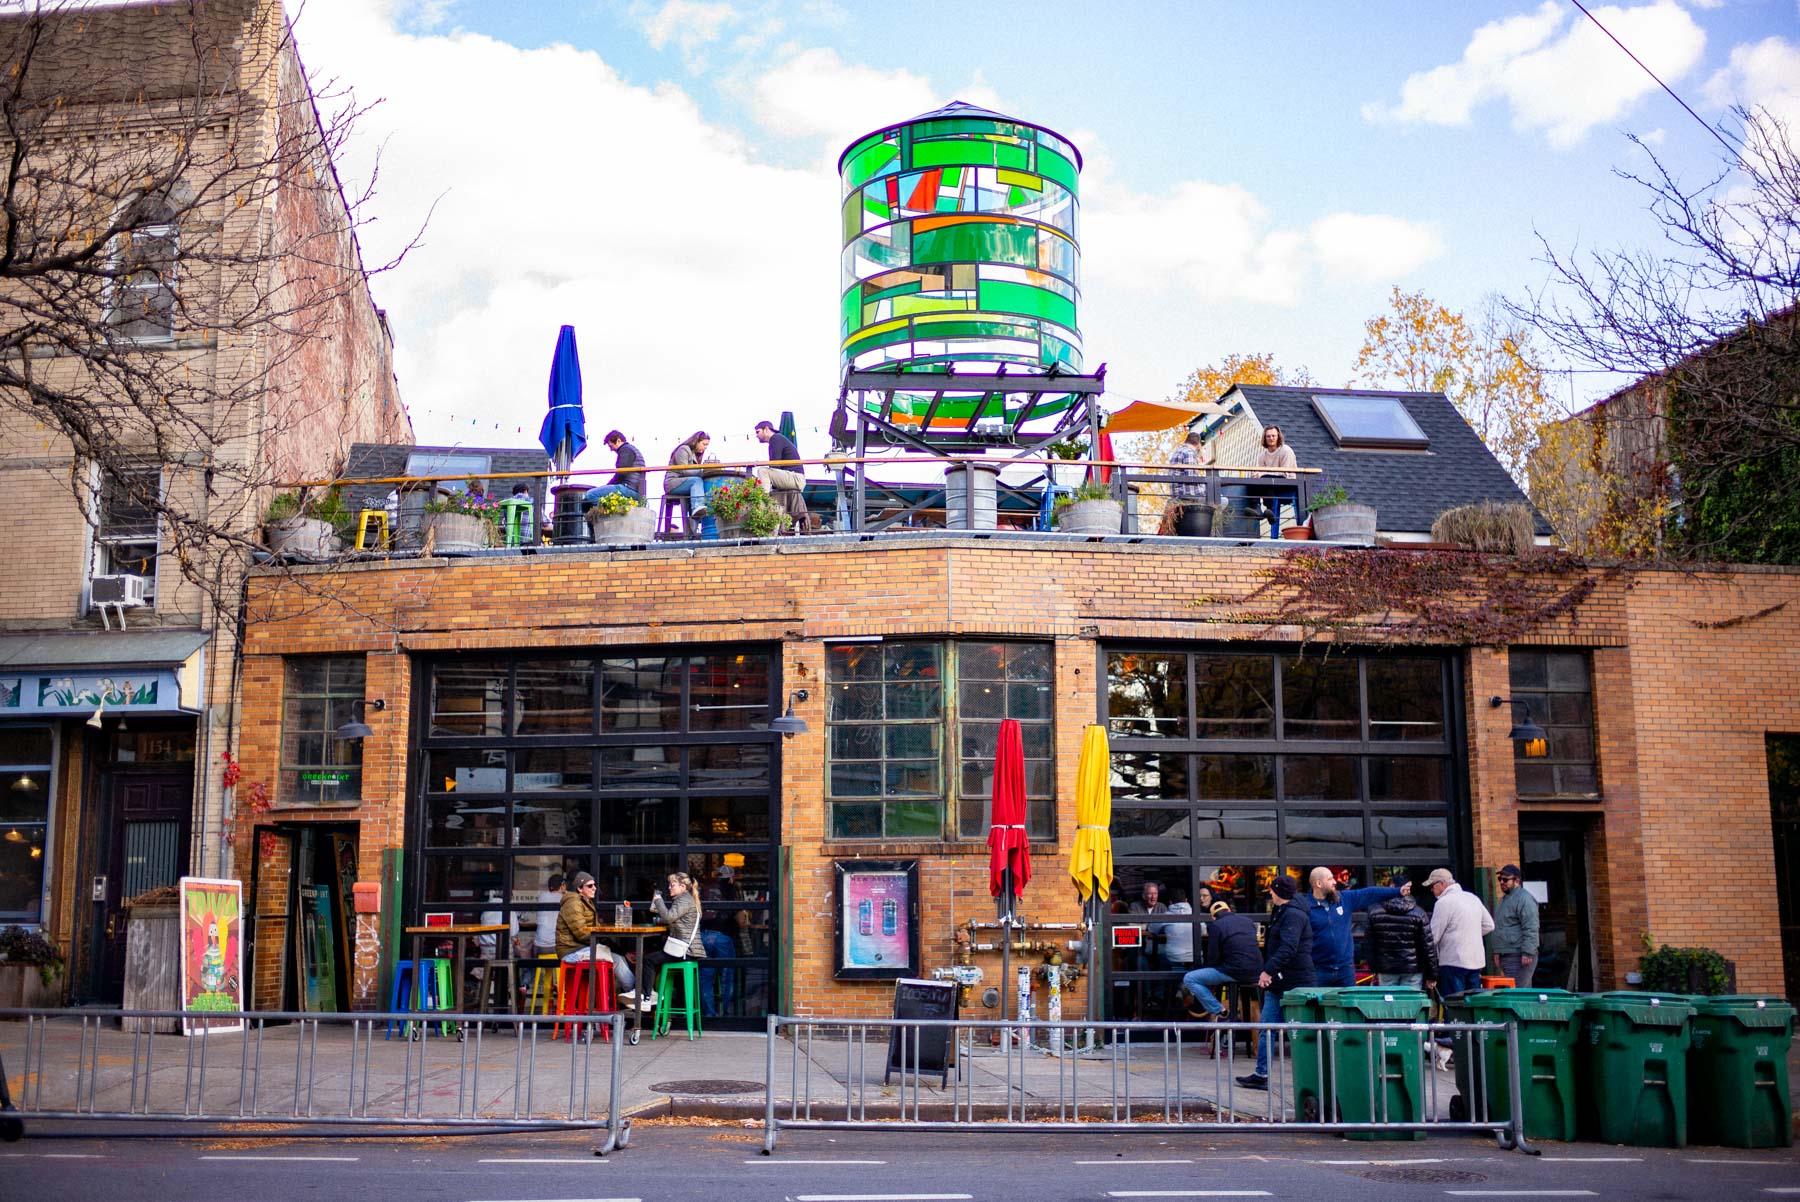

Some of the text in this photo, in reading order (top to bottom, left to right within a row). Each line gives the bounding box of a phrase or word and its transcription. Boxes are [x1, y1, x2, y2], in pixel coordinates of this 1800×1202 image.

[185, 891, 239, 916] TRIVIA
[1115, 928, 1139, 937] PRIVATE
[1118, 937, 1136, 945] DRIVE
